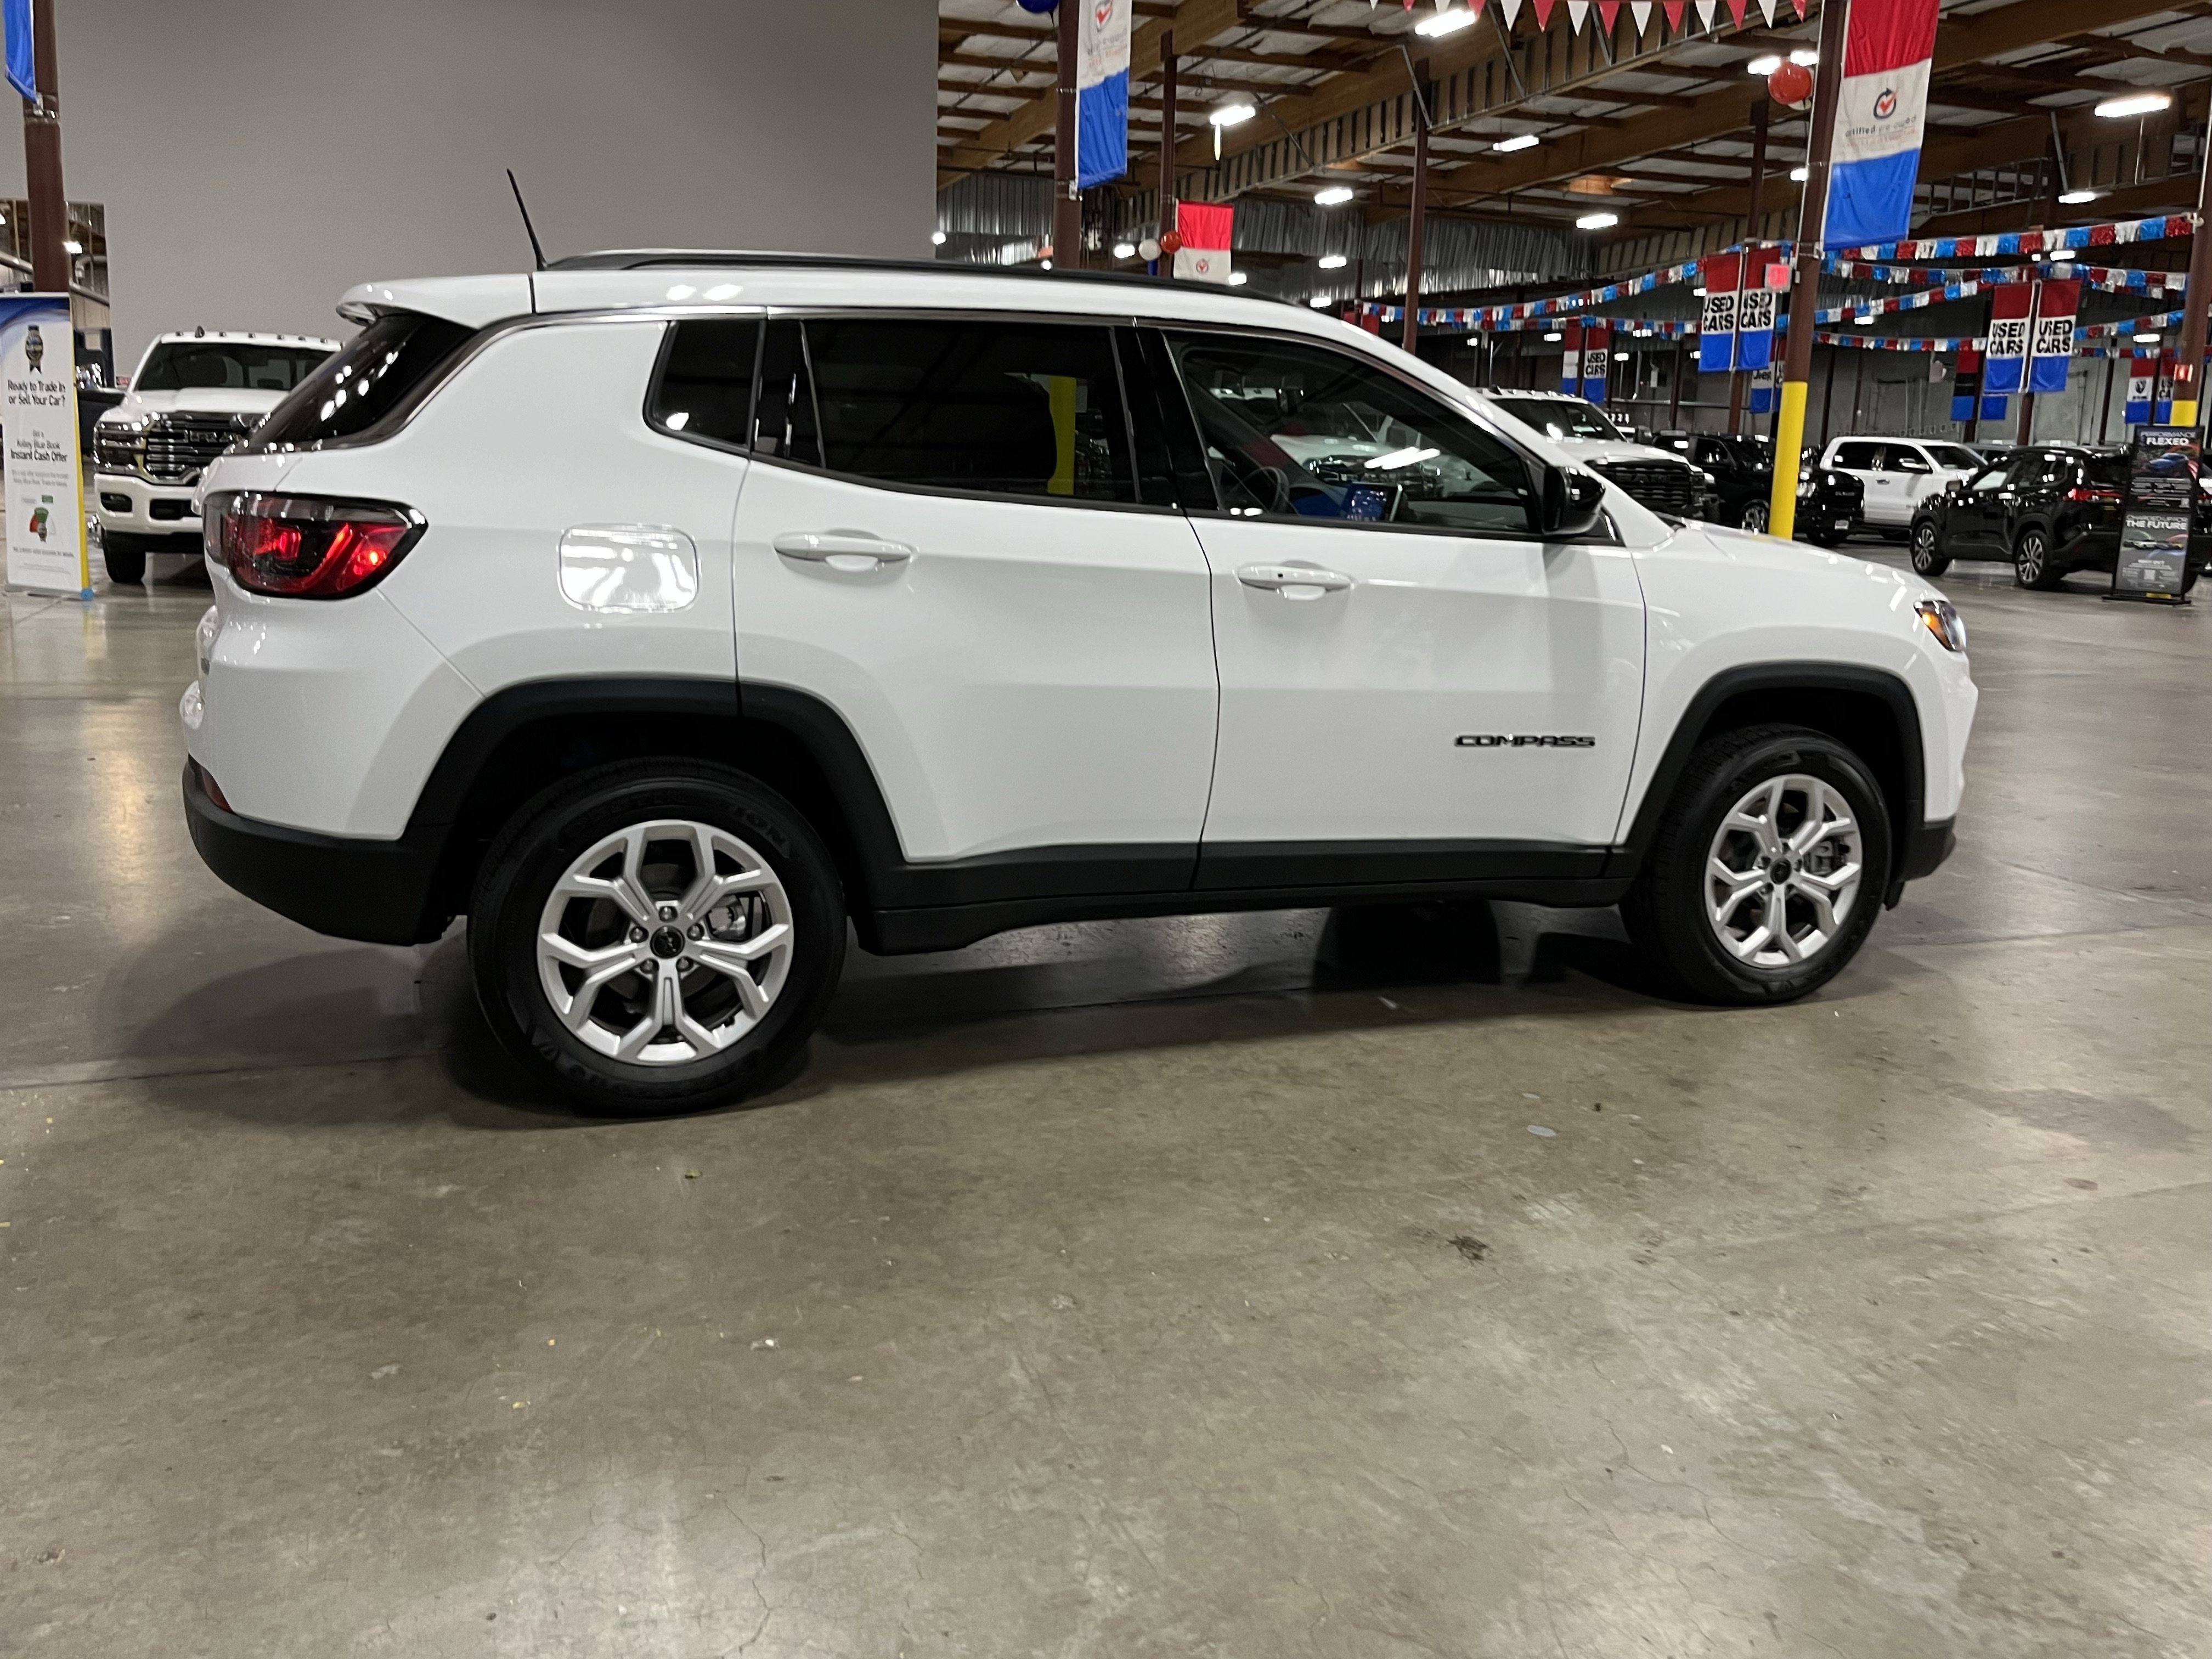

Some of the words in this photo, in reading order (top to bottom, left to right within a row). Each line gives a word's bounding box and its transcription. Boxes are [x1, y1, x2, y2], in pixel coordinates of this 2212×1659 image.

[1993, 322, 2025, 337] USED
[2039, 320, 2073, 335] USED
[1990, 339, 2023, 354] CARS
[2036, 337, 2070, 353] CARS
[1588, 352, 1606, 363] USED
[8, 380, 27, 394] Ready
[30, 381, 37, 391] to
[38, 380, 58, 392] Trade
[9, 396, 16, 404] or
[32, 395, 47, 405] Your
[49, 394, 65, 407] Car?
[2146, 437, 2190, 445] FLEXED
[34, 450, 50, 461] Cash
[2126, 520, 2146, 528] THE
[2147, 521, 2187, 531] FUTURE
[1454, 736, 1595, 747] COMPASS
